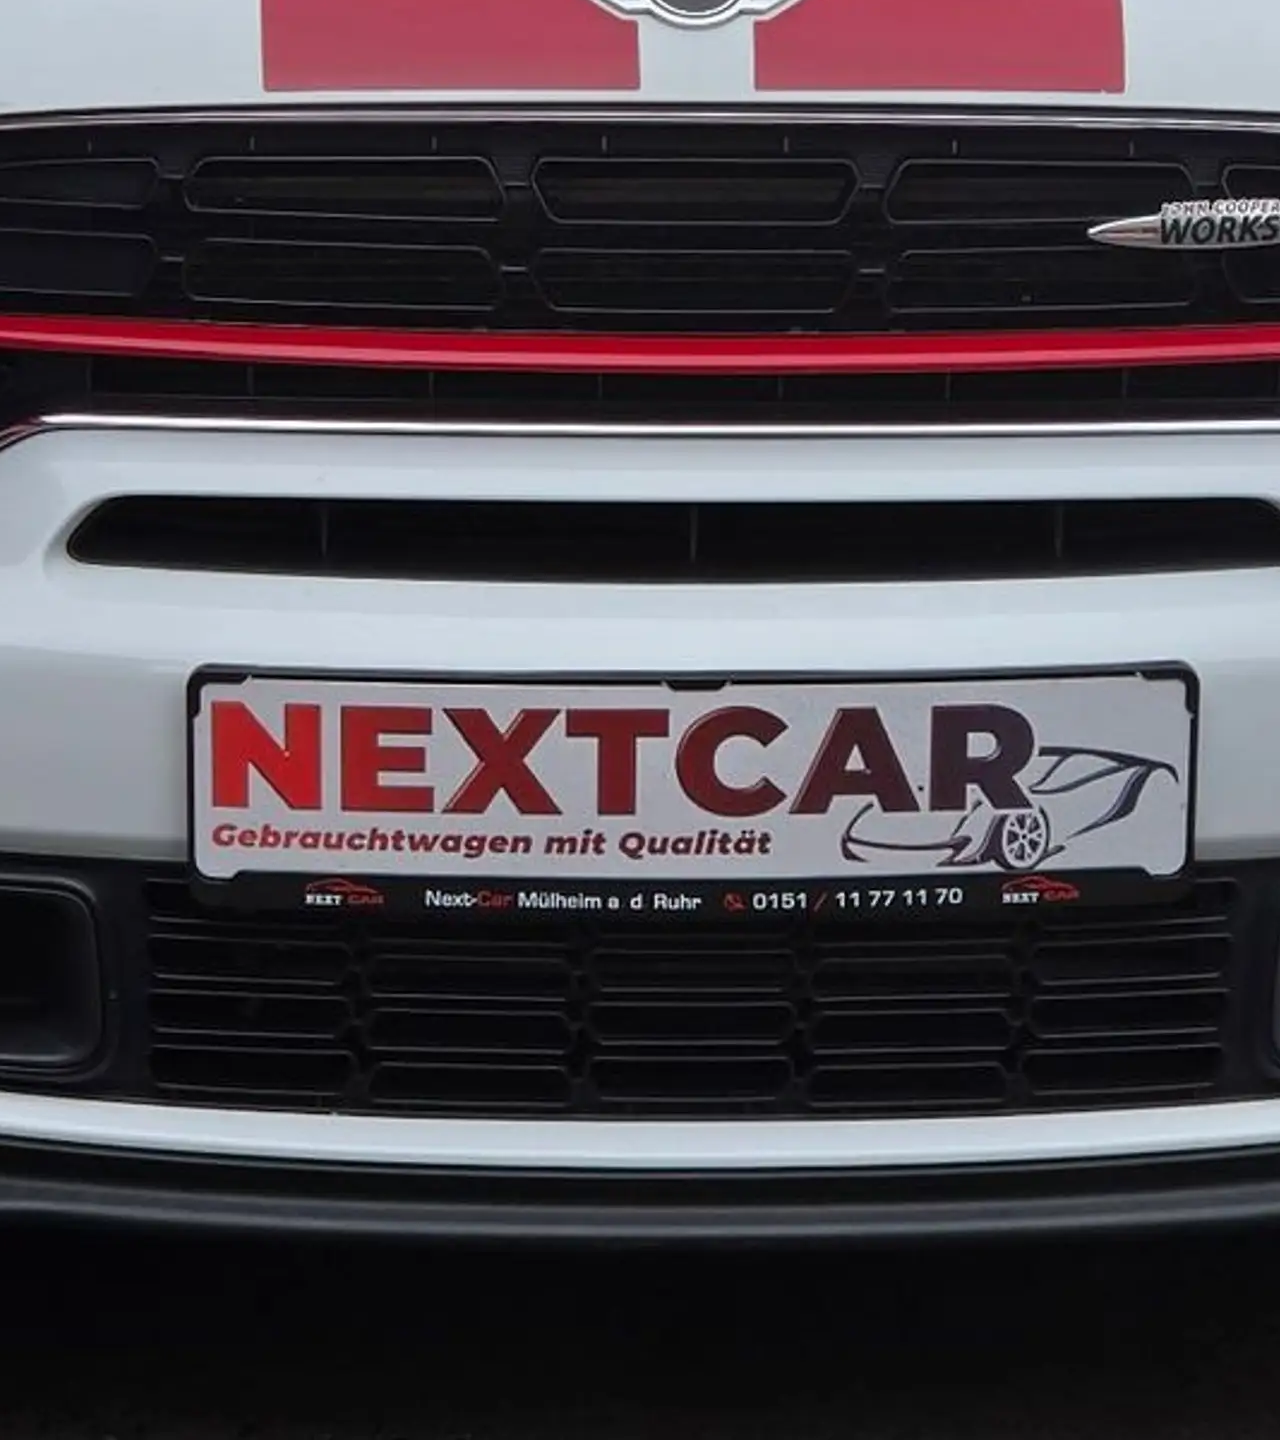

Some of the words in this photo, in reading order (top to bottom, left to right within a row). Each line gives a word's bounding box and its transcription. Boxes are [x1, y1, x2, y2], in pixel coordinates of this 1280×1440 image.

[1161, 202, 1209, 217] JOHN
[1212, 199, 1280, 214] COOPER
[1161, 215, 1280, 244] WORKS
[211, 700, 1033, 817] NEXTCAR
[212, 824, 533, 858] Gebrauchtwagen
[544, 828, 606, 855] mit
[619, 830, 771, 860] Qualität
[425, 889, 513, 908] Next-Car
[518, 891, 601, 910] Mülheim
[653, 892, 702, 910] Ruhr
[753, 892, 807, 910] 0151
[835, 892, 861, 908] 11
[868, 891, 895, 908] 77
[903, 889, 928, 906] 11
[935, 887, 964, 905] 70
